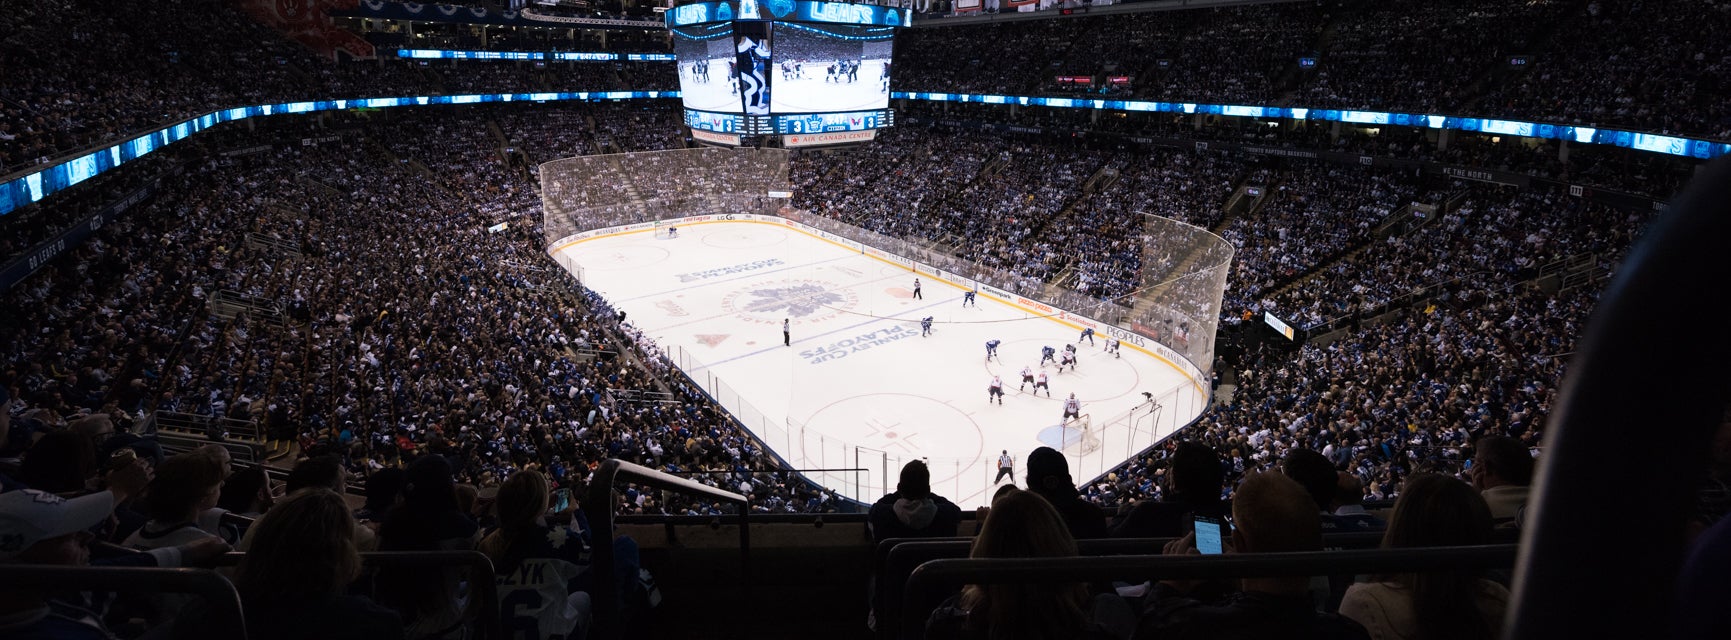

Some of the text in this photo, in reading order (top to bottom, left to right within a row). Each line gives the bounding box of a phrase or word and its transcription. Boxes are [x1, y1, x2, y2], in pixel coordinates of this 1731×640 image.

[675, 4, 707, 25] LEAFS
[810, 1, 873, 24] LEAFS
[725, 120, 733, 132] 3
[793, 120, 802, 132] 3
[867, 117, 875, 128] 3
[802, 132, 872, 143] AIR CANADA CENTRE
[1453, 168, 1466, 177] THE
[1467, 170, 1493, 181] NORTH
[986, 286, 1011, 300] Greenpark
[1018, 296, 1053, 314] pizza pizza
[1066, 313, 1098, 330] Scotiabank
[799, 324, 904, 360] PLAYOFFS
[1106, 325, 1145, 348] PEOPLES
[810, 328, 919, 365] STANLEY CUP
